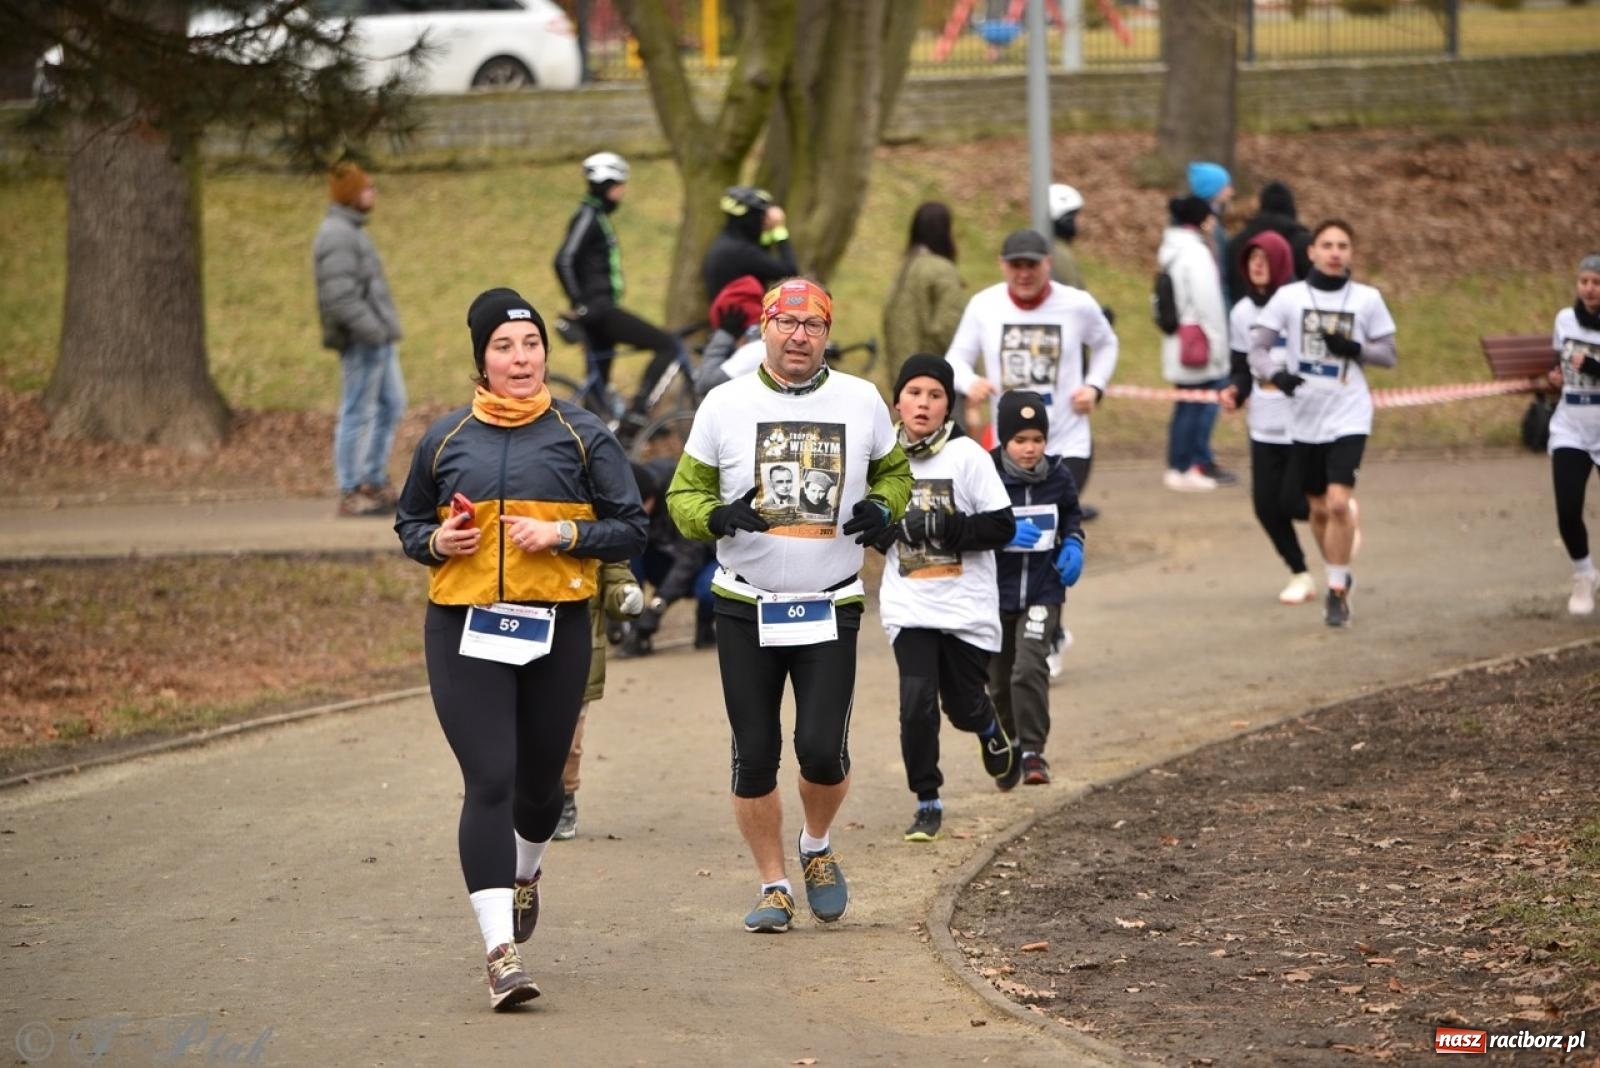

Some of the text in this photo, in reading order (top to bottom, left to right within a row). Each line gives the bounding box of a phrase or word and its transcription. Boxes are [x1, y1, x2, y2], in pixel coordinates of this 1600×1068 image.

[789, 440, 841, 454] WICZYM
[787, 605, 805, 618] 60
[499, 618, 520, 632] 59
